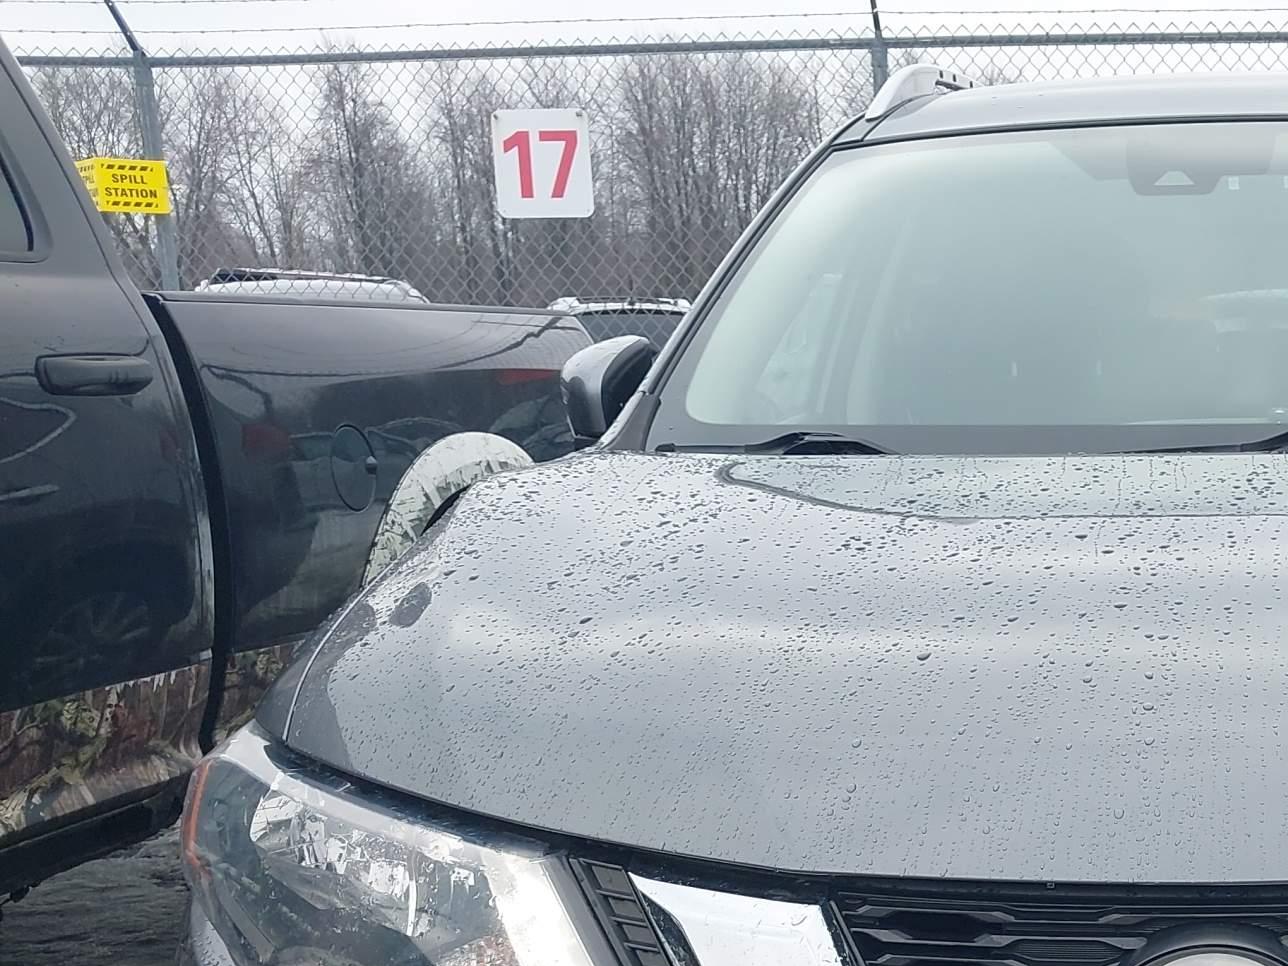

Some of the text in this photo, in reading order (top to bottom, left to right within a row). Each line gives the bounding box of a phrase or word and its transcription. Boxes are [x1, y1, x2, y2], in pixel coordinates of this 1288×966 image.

[502, 129, 579, 199] 17
[111, 173, 148, 185] SPILL
[104, 186, 158, 199] STATION
